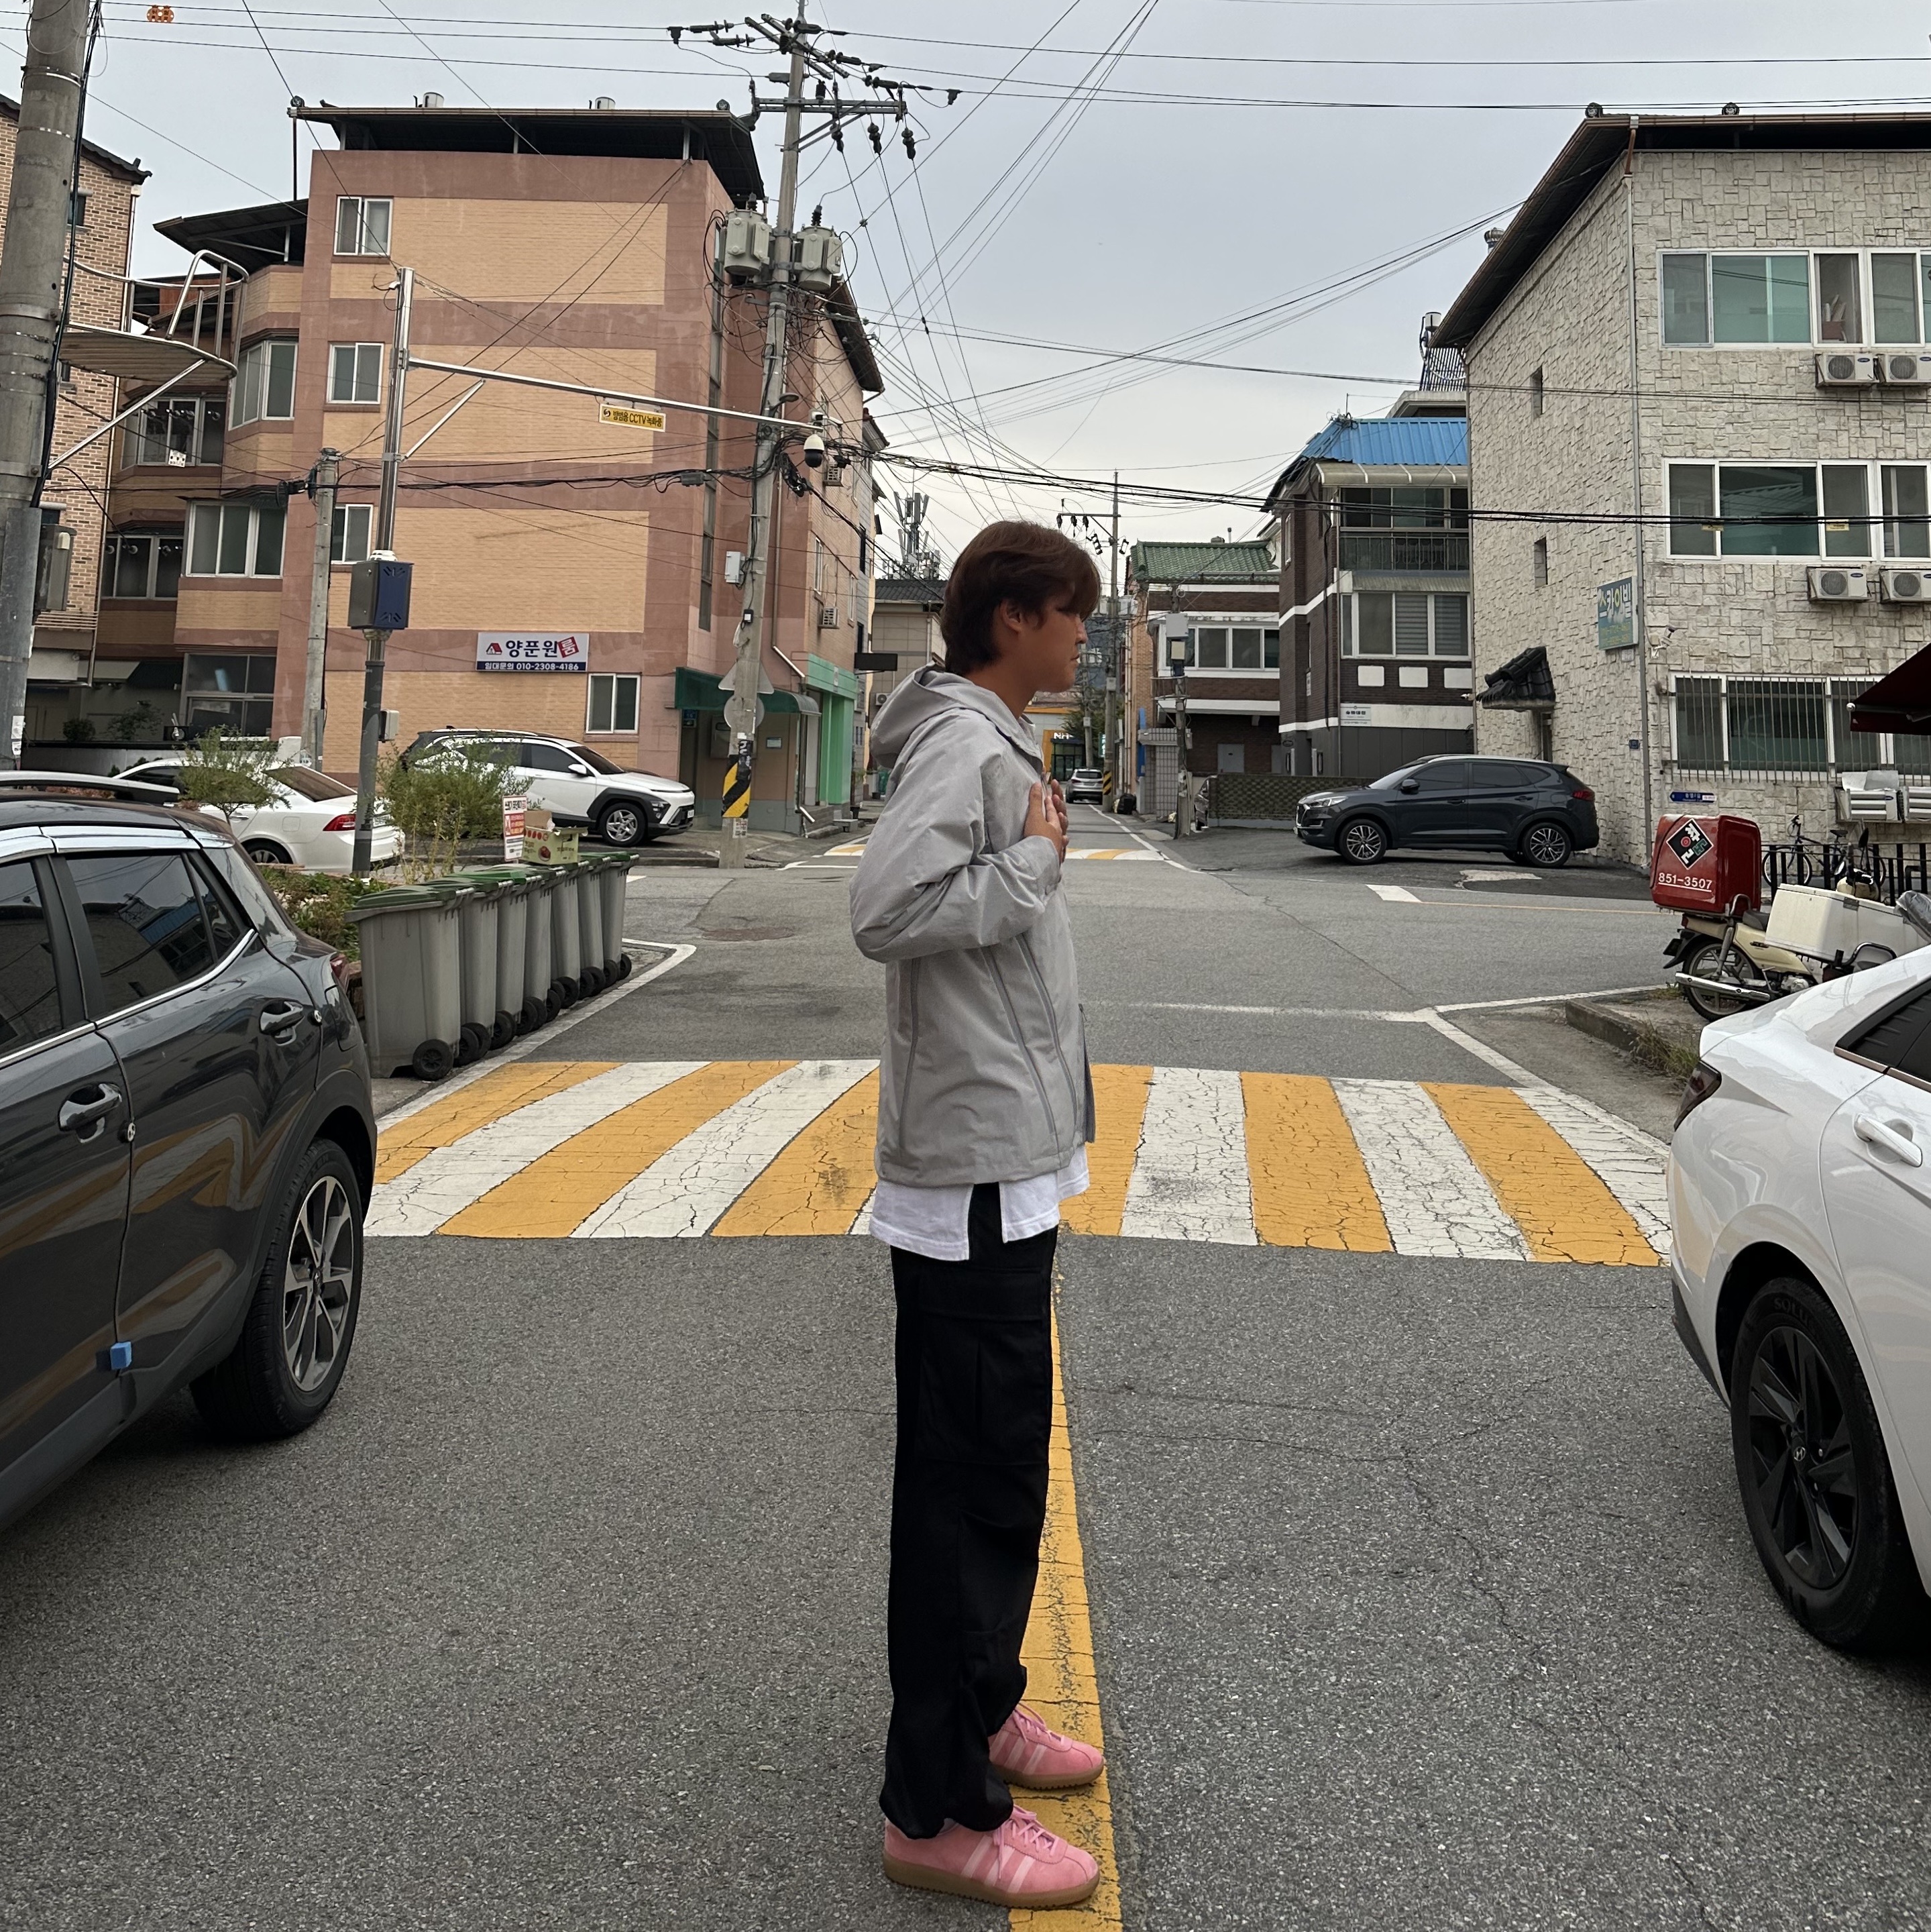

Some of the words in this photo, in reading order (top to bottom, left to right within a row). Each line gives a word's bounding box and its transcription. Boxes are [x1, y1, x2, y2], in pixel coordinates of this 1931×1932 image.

[629, 413, 647, 424] CCTV
[1598, 582, 1632, 619] 스카이빌
[506, 639, 577, 657] 양푼원룸
[485, 662, 514, 670] 임대문의
[516, 662, 579, 670] 010-2308-4186
[1658, 872, 1712, 890] 851-3507
